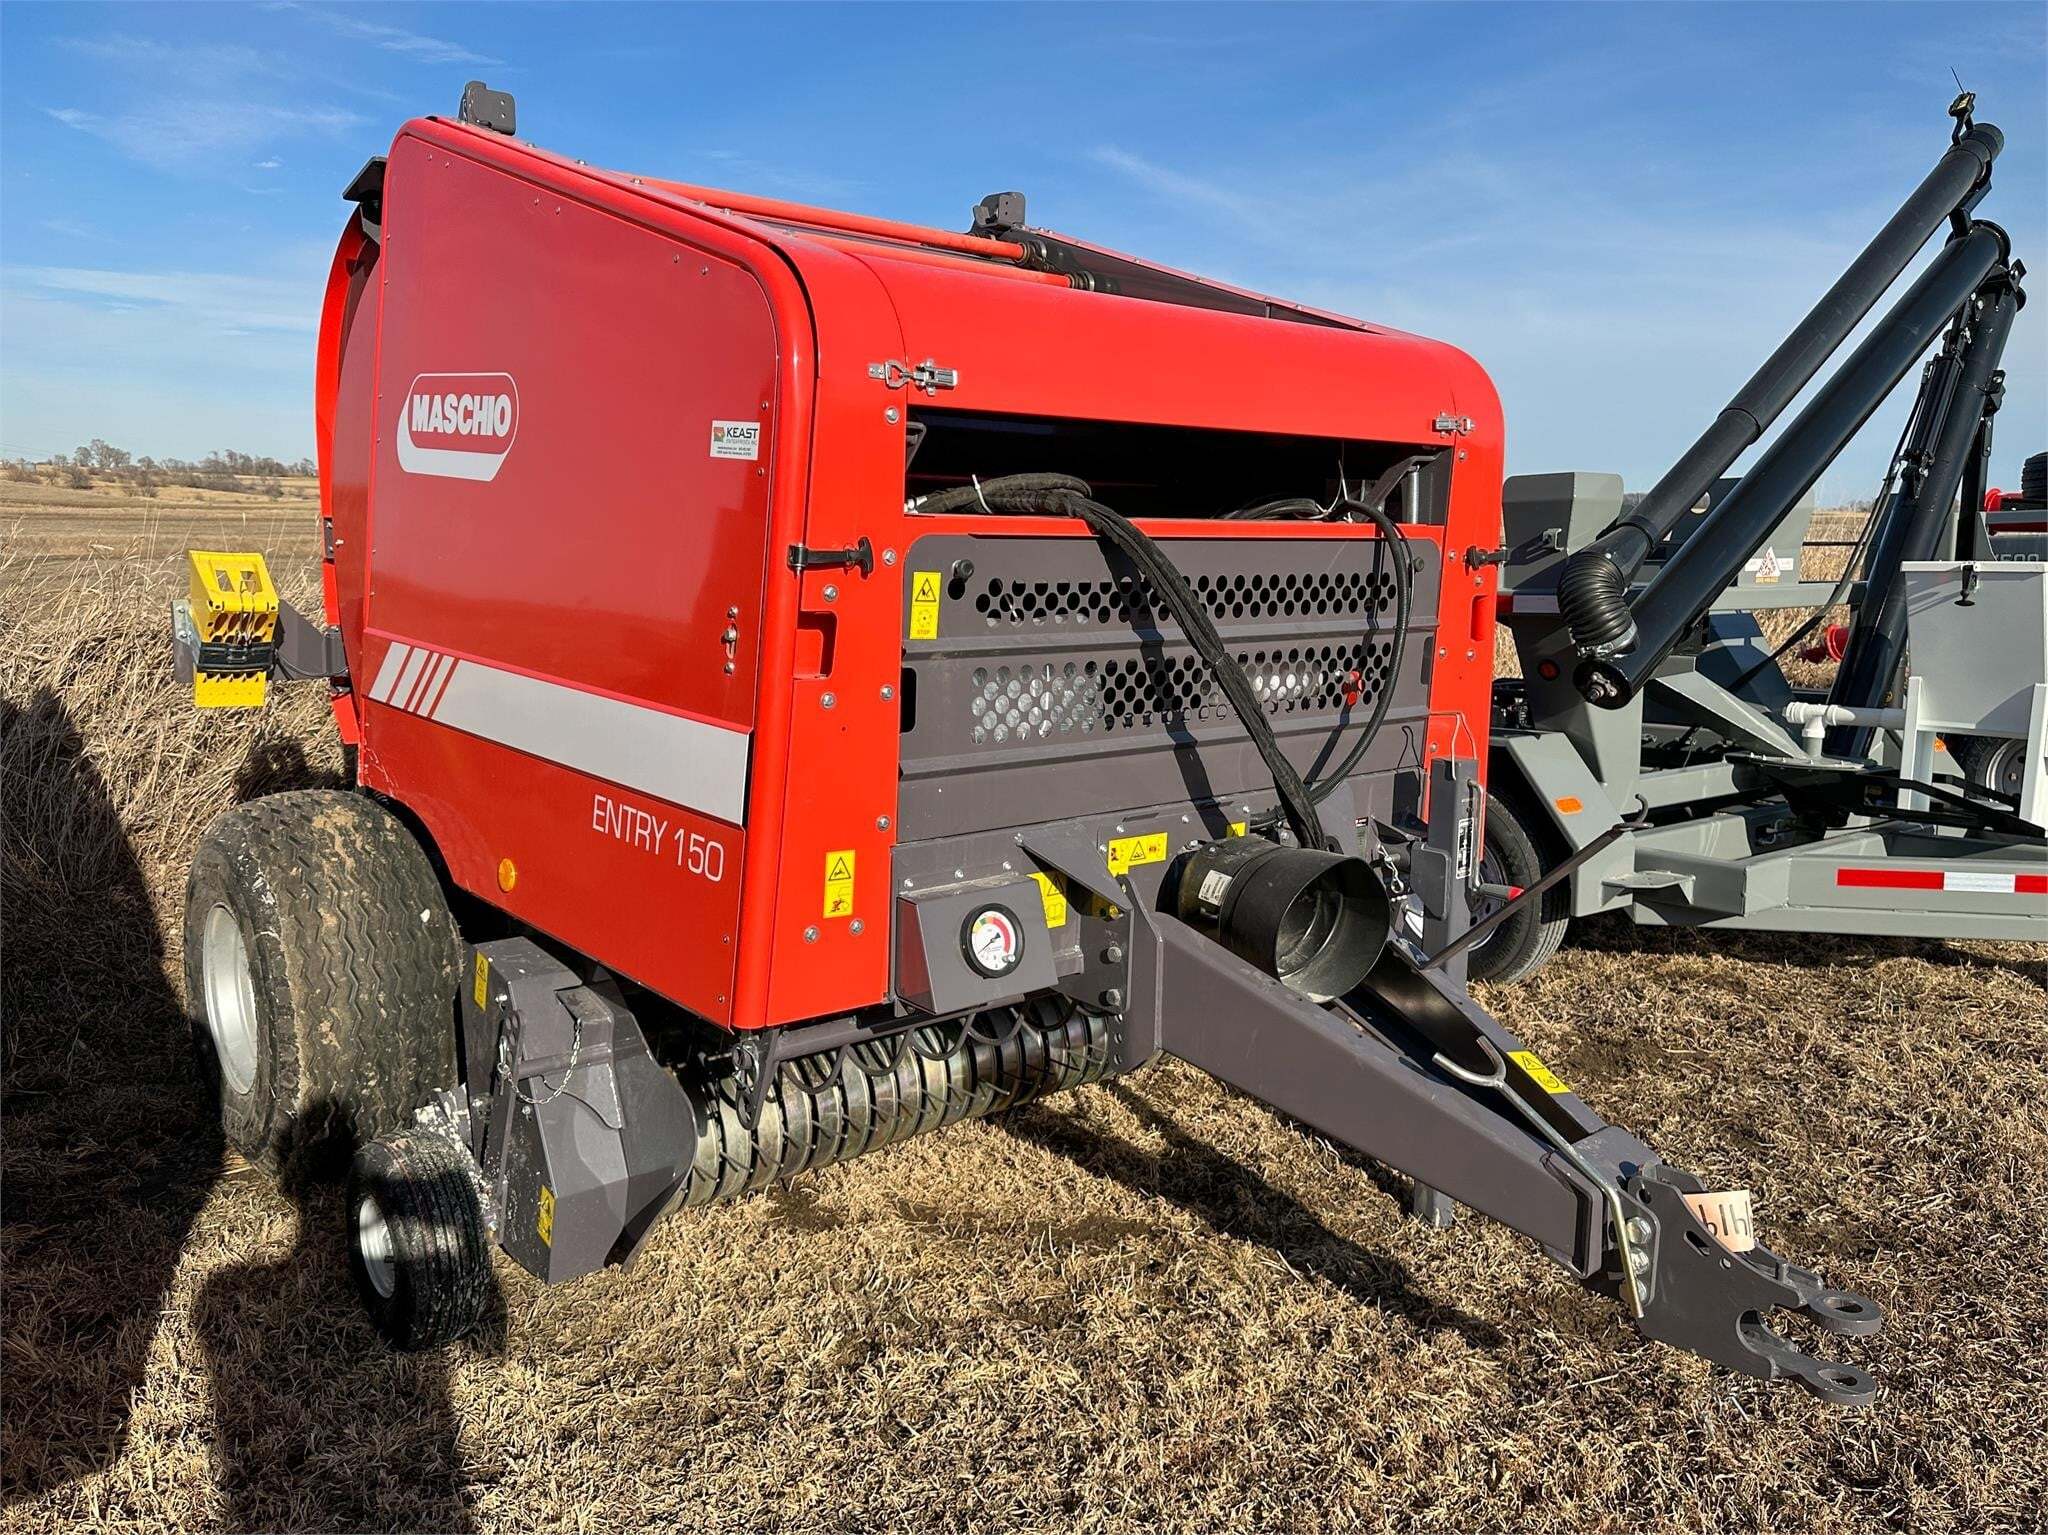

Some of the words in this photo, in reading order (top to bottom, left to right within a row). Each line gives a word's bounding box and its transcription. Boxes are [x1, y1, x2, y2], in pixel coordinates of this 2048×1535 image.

[412, 393, 512, 437] MASCHIO
[726, 427, 758, 439] KEAST
[592, 794, 668, 855] ENTRY
[674, 828, 724, 882] 150
